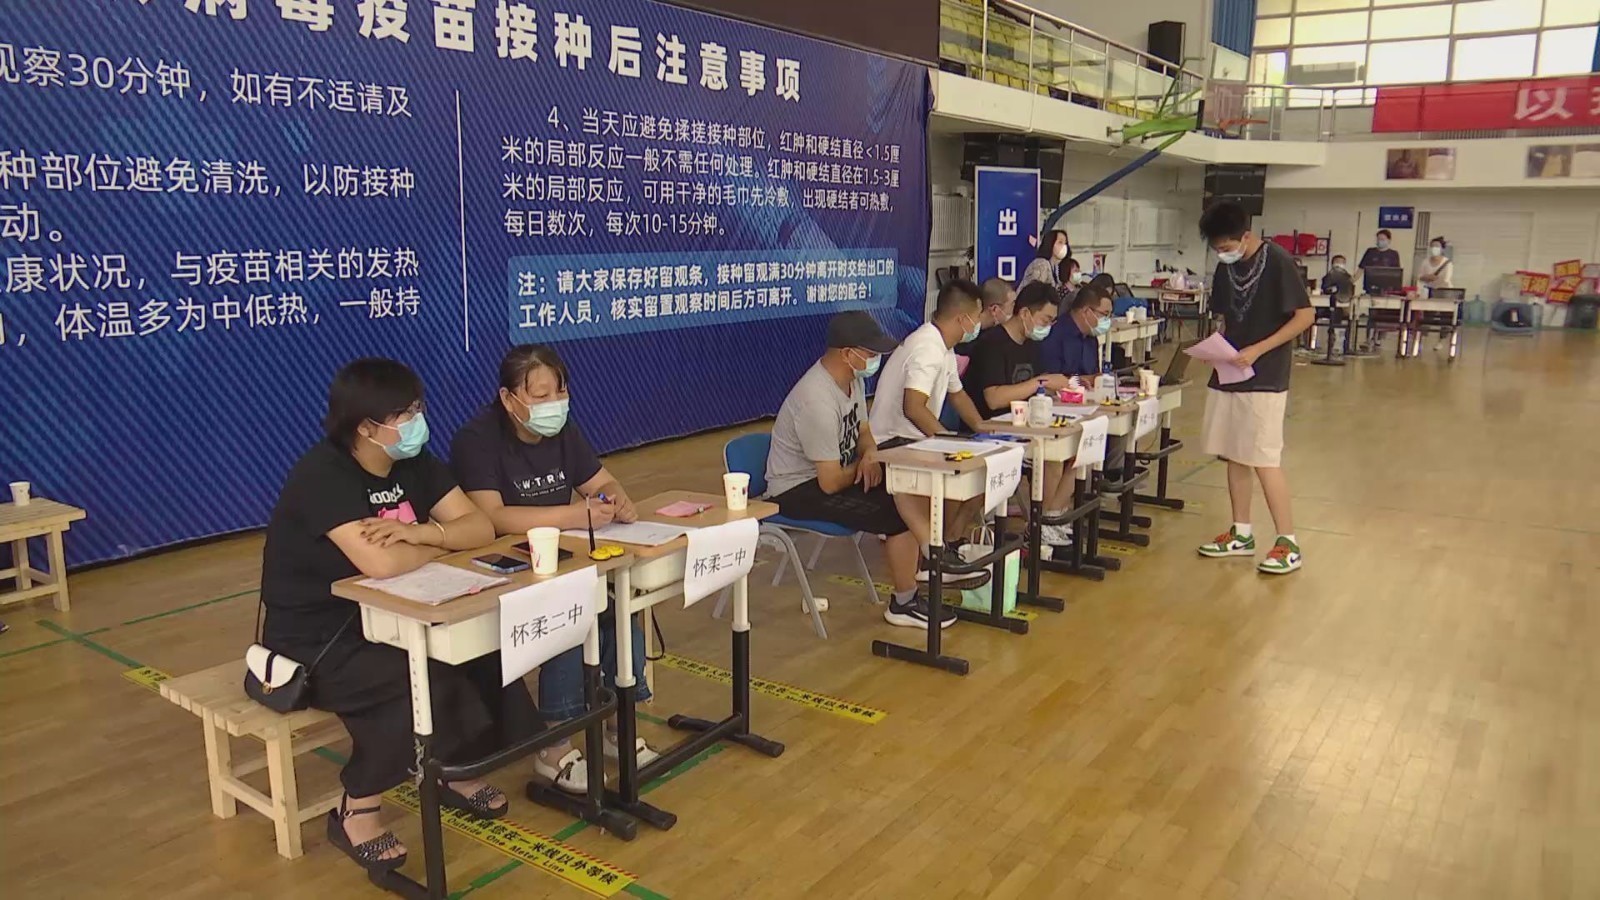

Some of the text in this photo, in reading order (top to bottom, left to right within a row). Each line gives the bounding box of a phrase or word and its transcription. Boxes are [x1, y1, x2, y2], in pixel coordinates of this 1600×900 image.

[1513, 86, 1600, 121] 以
[998, 208, 1018, 281] 出口
[0, 286, 421, 347] ，体温多为中低热，一般持
[692, 547, 747, 578] 怀柔二中
[510, 603, 584, 648] 怀柔二中
[486, 834, 506, 847] One
[509, 844, 540, 862] Meter
[542, 859, 565, 874] Line
